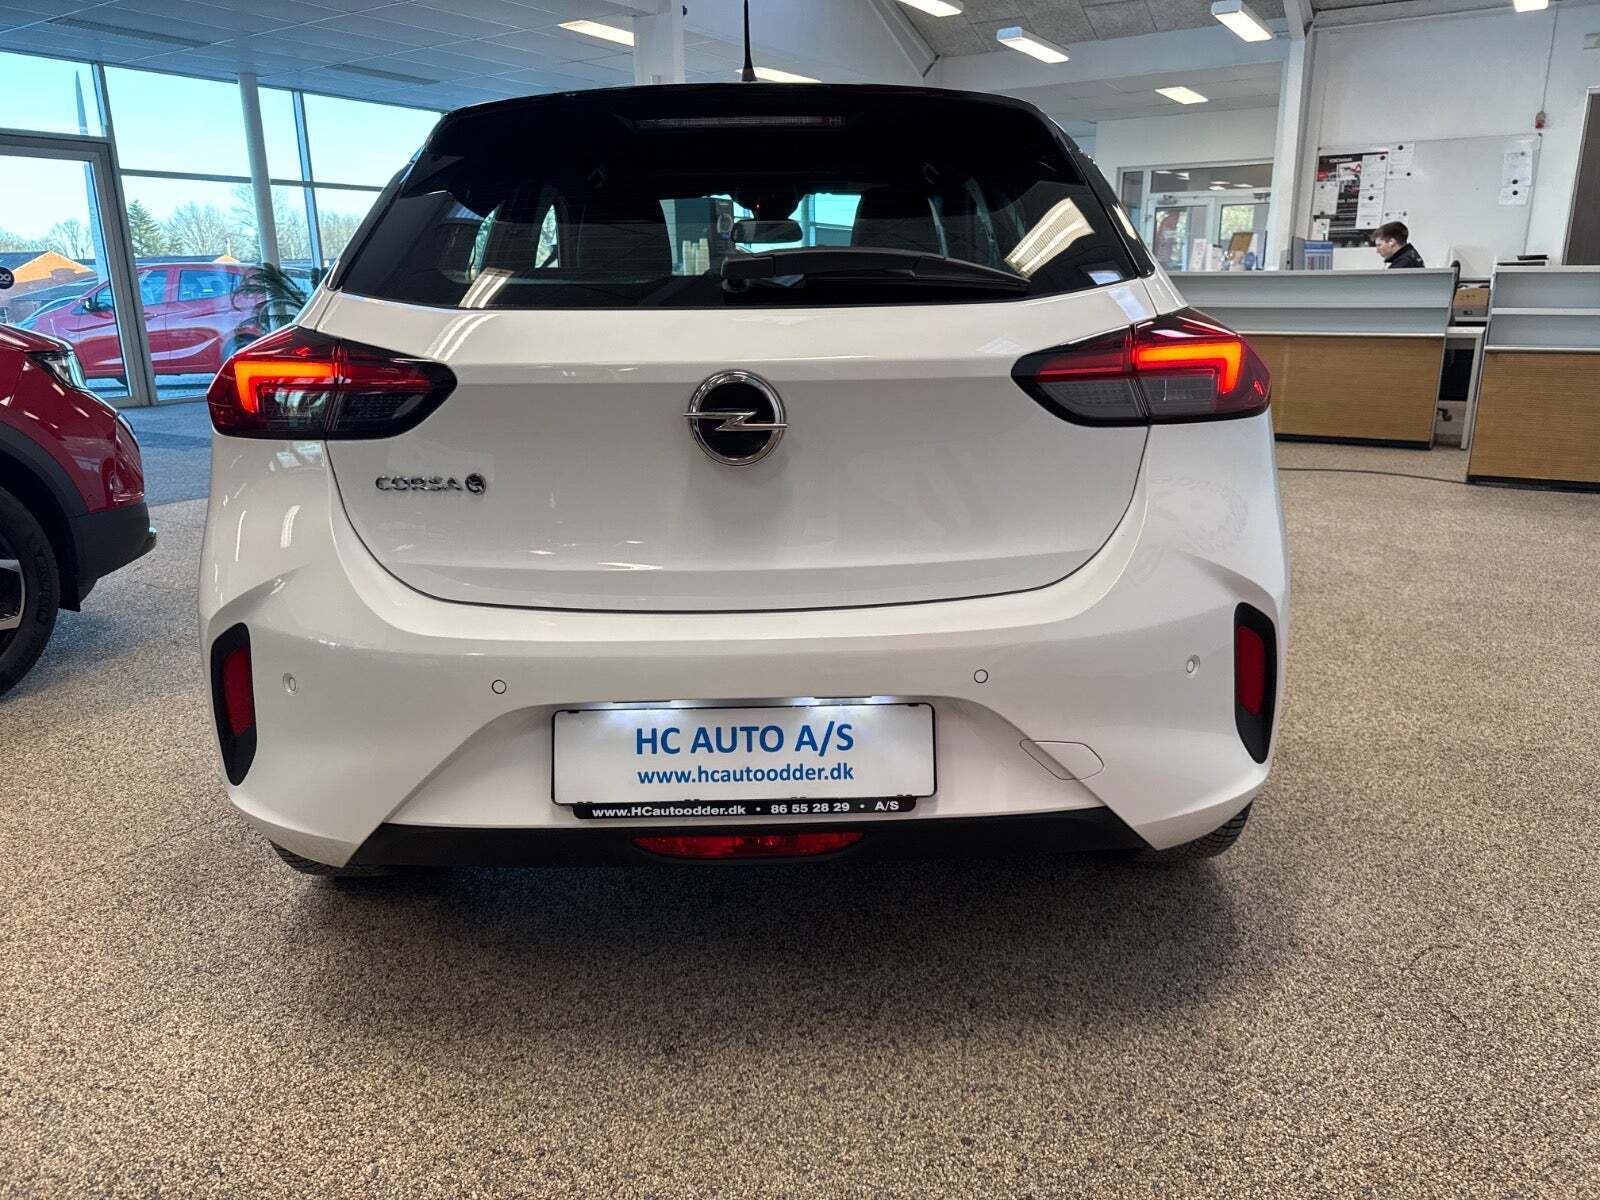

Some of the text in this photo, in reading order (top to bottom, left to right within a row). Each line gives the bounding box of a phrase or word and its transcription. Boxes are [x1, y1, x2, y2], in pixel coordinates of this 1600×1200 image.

[375, 476, 464, 491] CORSA
[636, 720, 854, 757] HC AUTO A/S
[637, 762, 855, 784] www.hcautoodder.dk
[592, 800, 900, 818] www.HCautoodder.dk 86 55 28 29 A/S
